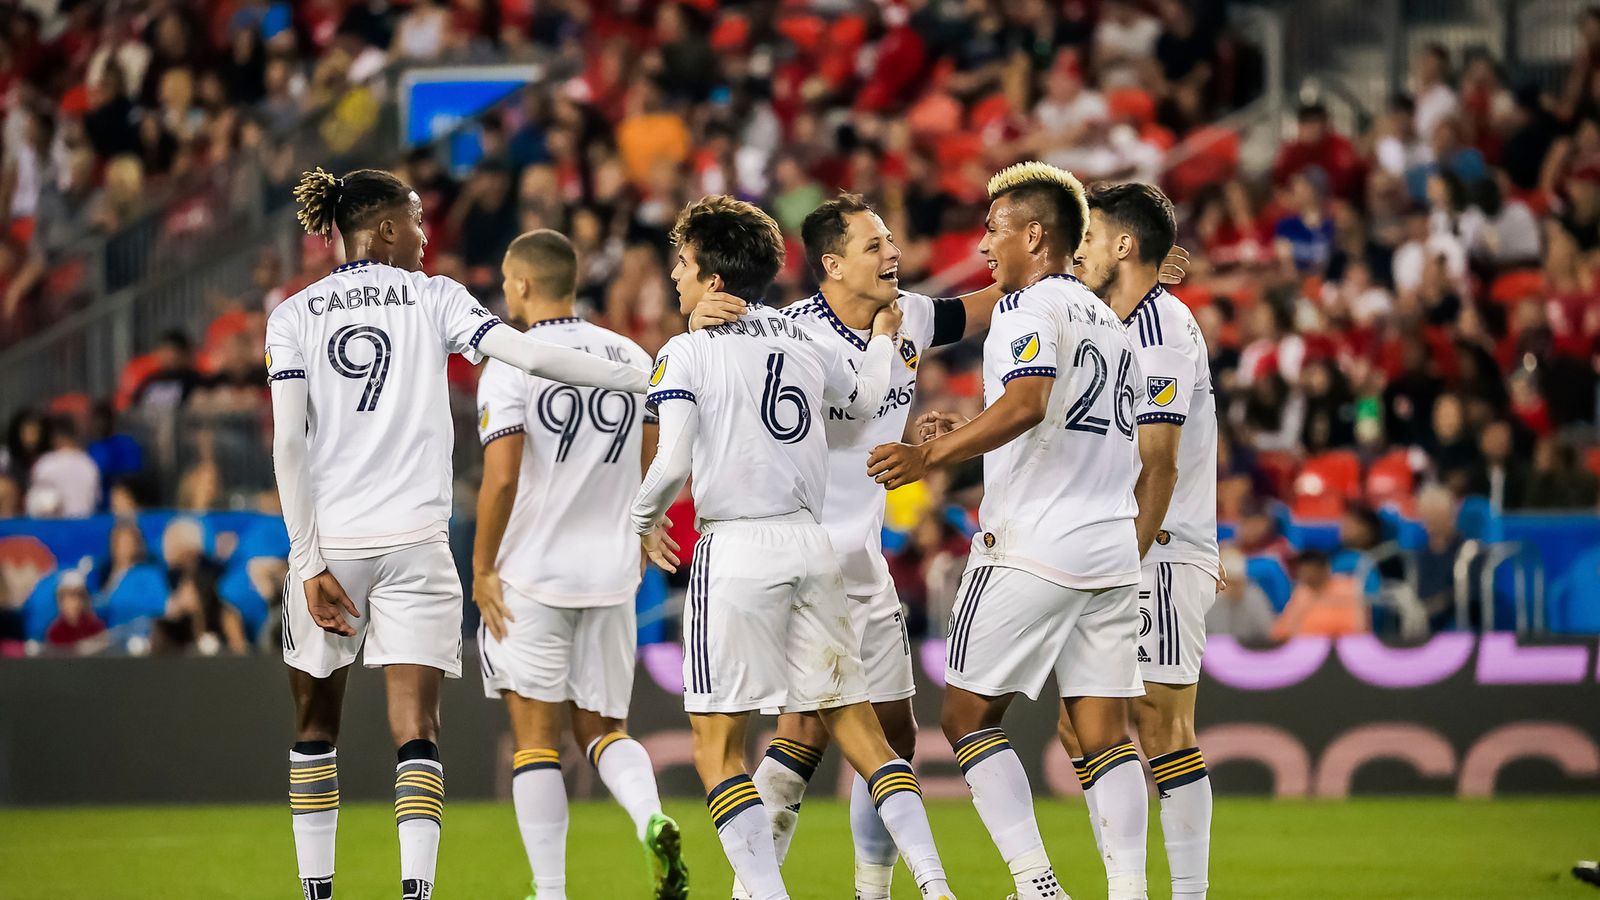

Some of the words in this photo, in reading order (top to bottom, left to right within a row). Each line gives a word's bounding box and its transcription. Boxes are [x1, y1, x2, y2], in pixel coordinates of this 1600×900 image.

[308, 285, 416, 316] CABRAL
[327, 323, 392, 411] 9
[903, 346, 916, 360] LA
[1065, 338, 1134, 441] 26
[1150, 379, 1166, 387] MLS
[537, 383, 636, 463] 99
[761, 353, 811, 444] 6
